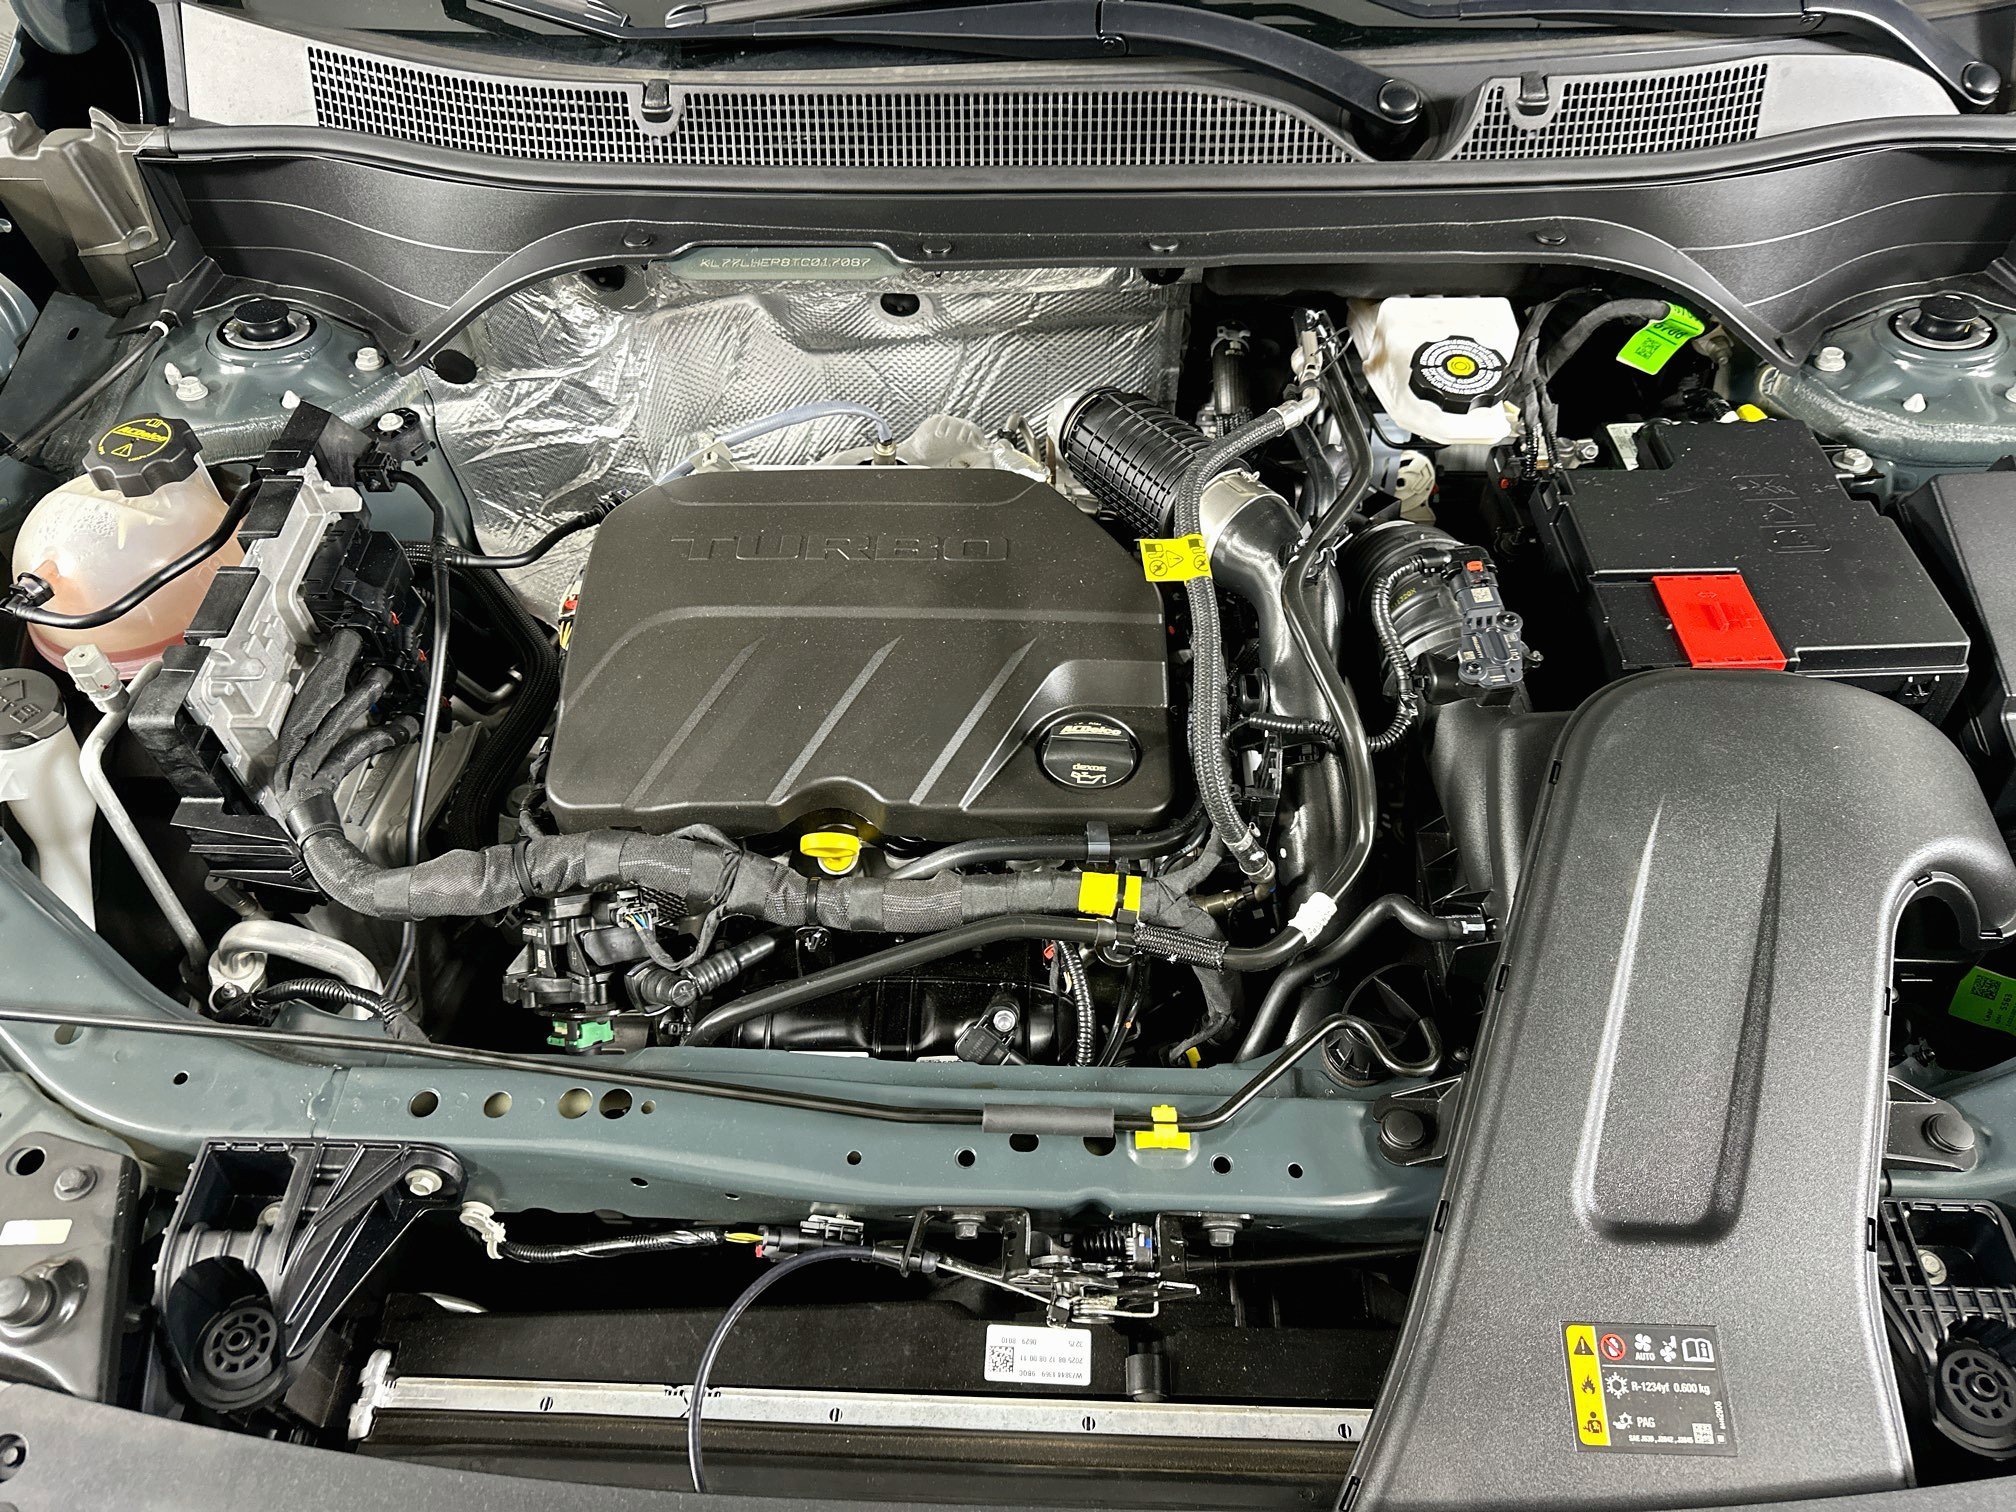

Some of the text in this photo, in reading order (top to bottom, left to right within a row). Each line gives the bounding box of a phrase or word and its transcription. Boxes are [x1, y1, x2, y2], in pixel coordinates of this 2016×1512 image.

[671, 535, 1009, 561] TURBO
[1059, 725, 1122, 736] ACDelco
[1072, 763, 1107, 771] dexos
[1635, 1352, 1656, 1361] AUTO
[1631, 1382, 1711, 1396] R-1234yf 0.600 kg
[1636, 1416, 1656, 1429] PAG
